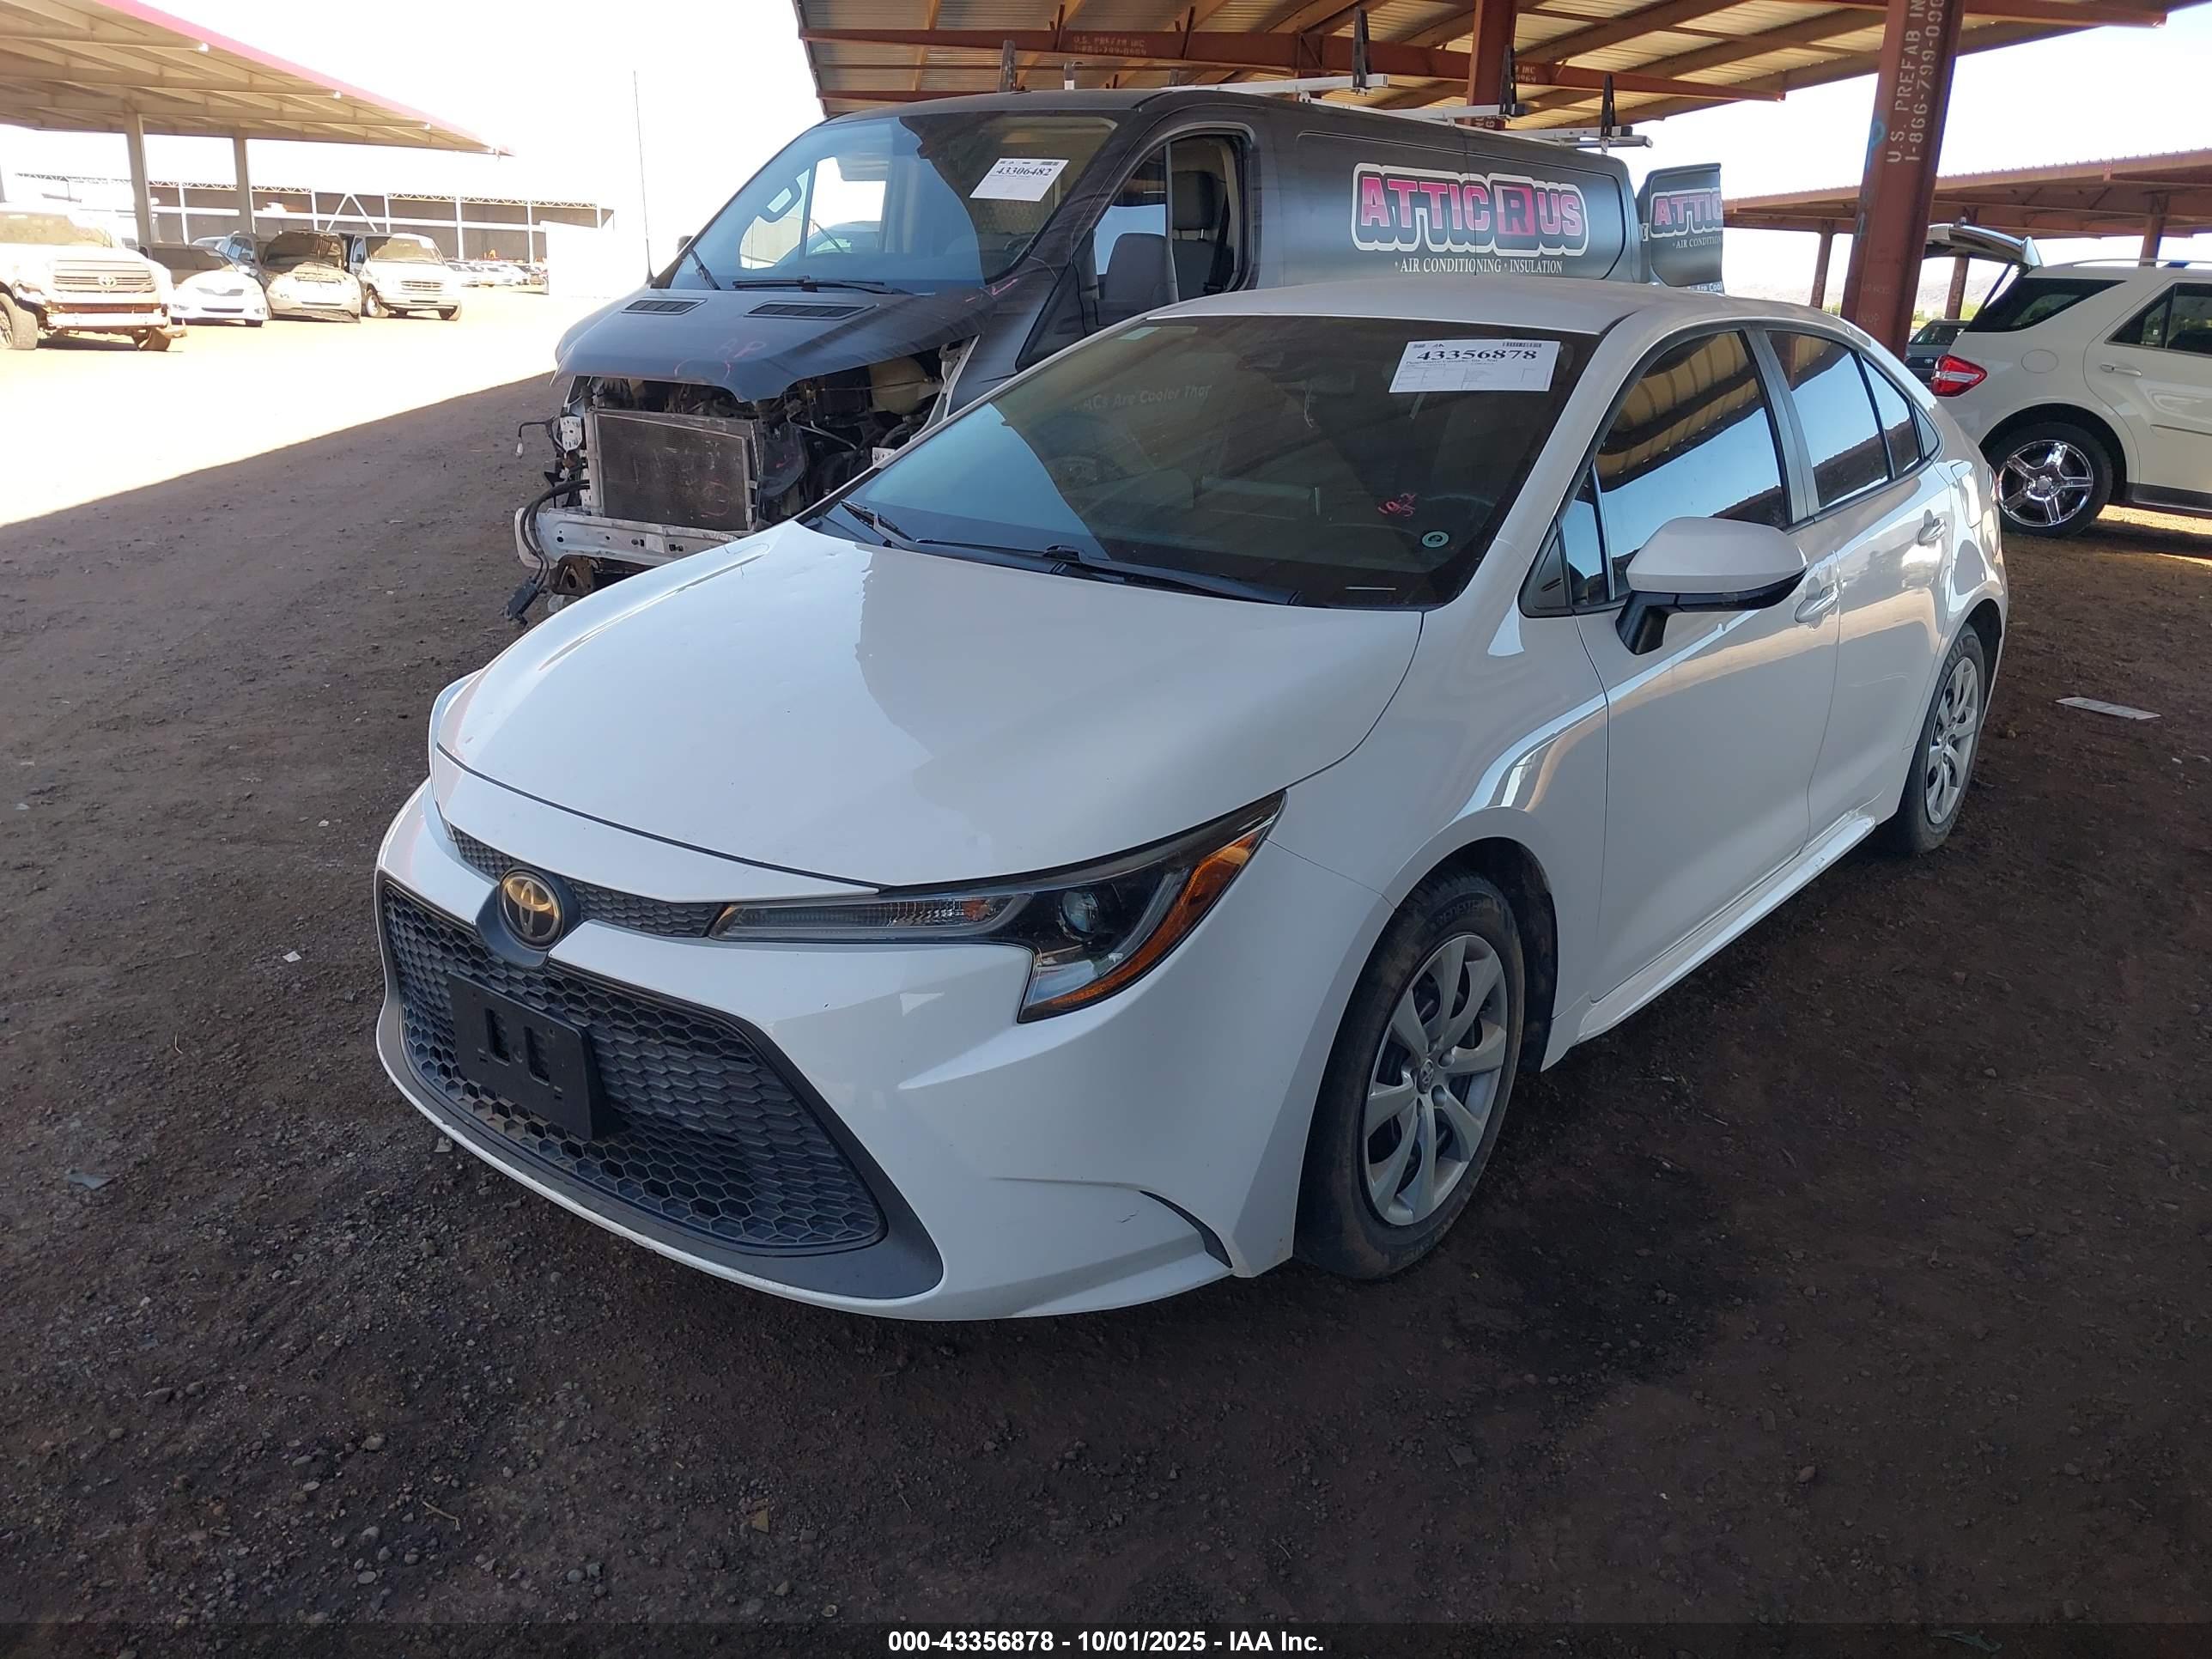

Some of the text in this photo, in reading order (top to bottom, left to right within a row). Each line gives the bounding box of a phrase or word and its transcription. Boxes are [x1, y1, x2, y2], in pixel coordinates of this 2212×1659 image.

[1894, 30, 1921, 111] PREFAB
[1887, 125, 1906, 162] U.S.
[996, 167, 1053, 176] 43306482
[1360, 176, 1490, 232] ATTIC
[1676, 239, 1687, 249] AIR
[1400, 258, 1564, 274] AIR CONDITIONING INSULATION
[1416, 349, 1538, 361] 43356878
[1139, 387, 1182, 404] Cooler
